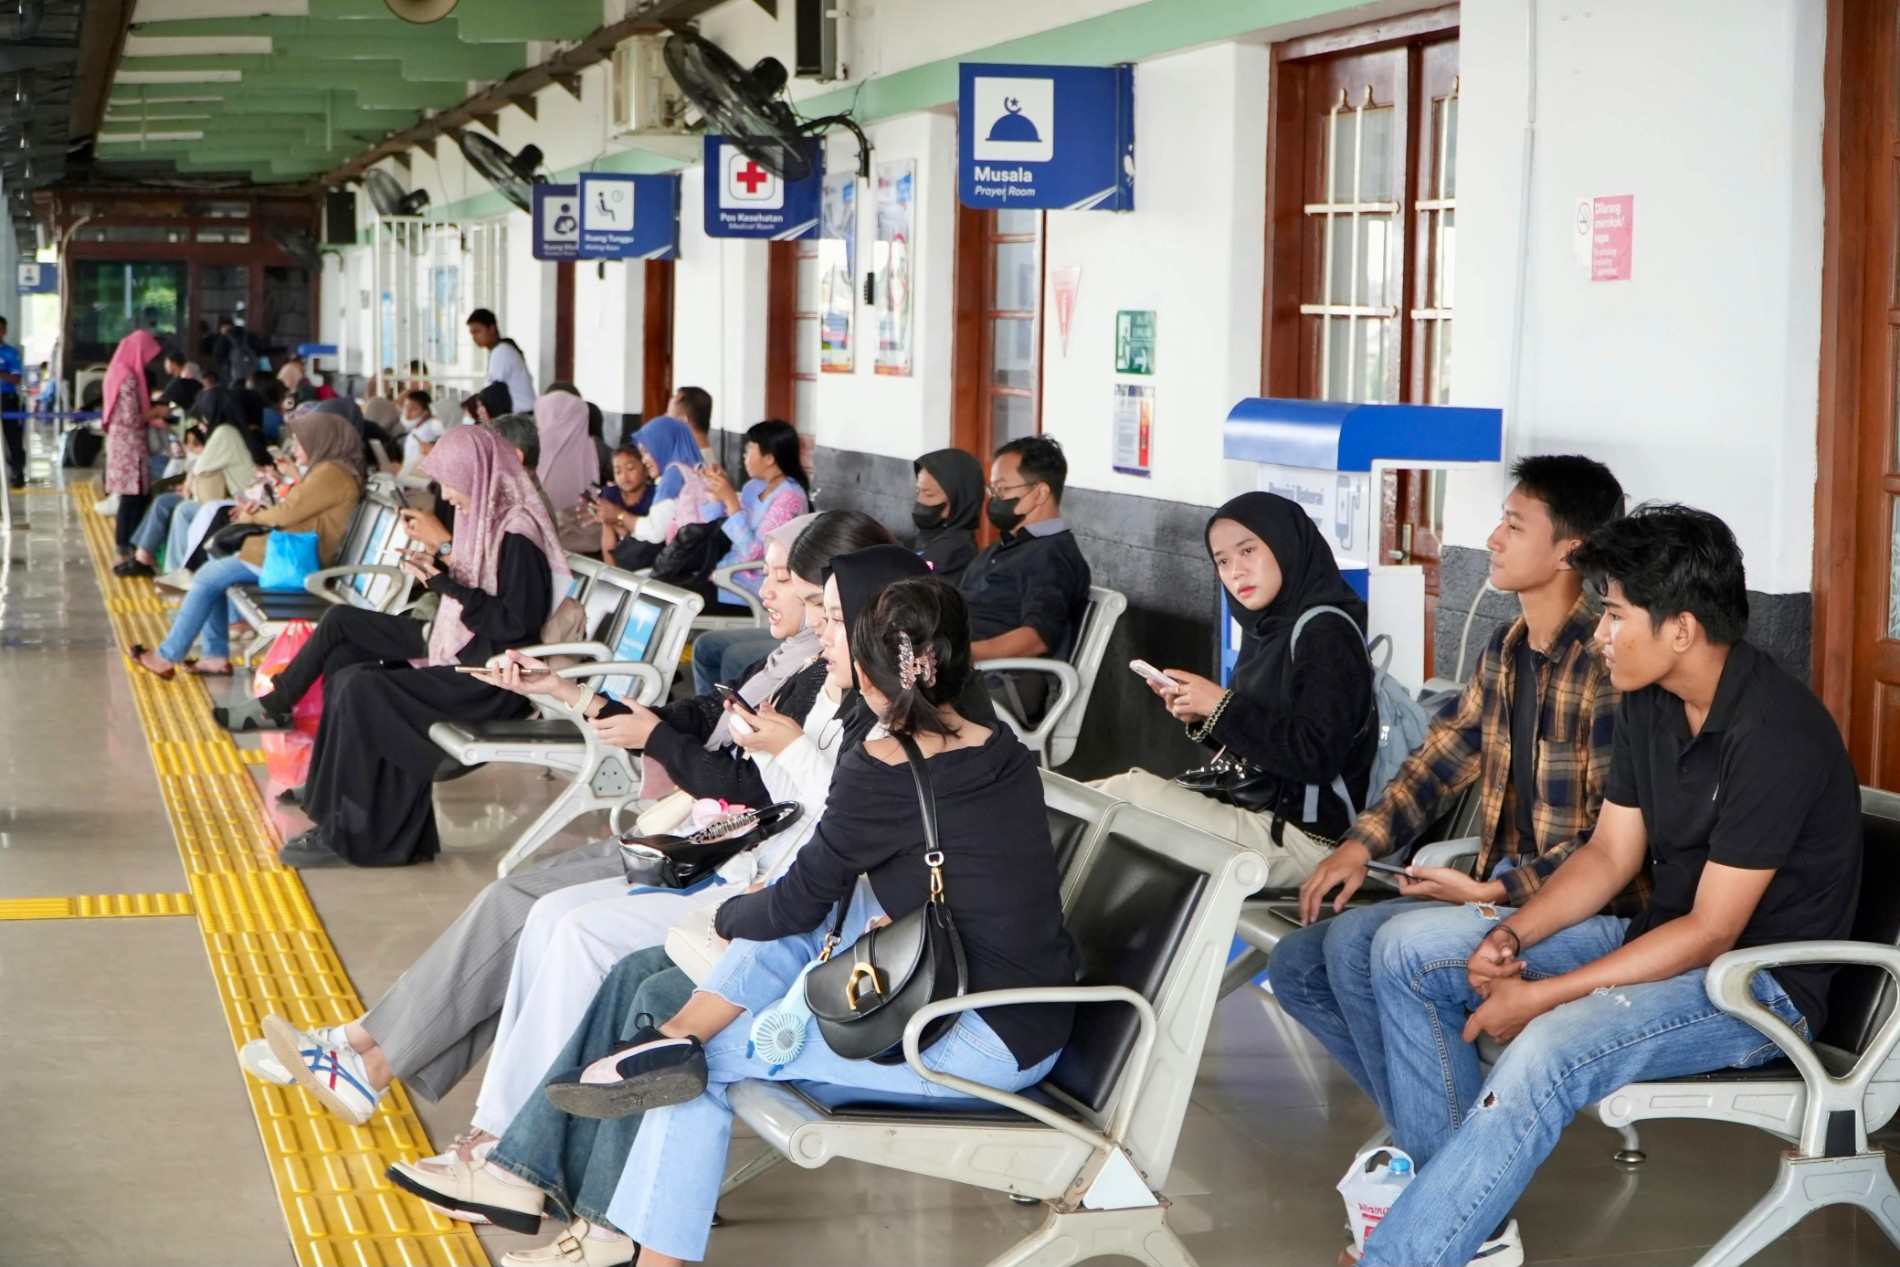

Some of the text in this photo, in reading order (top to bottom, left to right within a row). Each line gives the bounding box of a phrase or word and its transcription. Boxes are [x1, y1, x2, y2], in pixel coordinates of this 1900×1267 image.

[974, 166, 1033, 183] Musala
[974, 185, 1036, 199] Prayer Room
[720, 212, 784, 223] Pos Kesehatan
